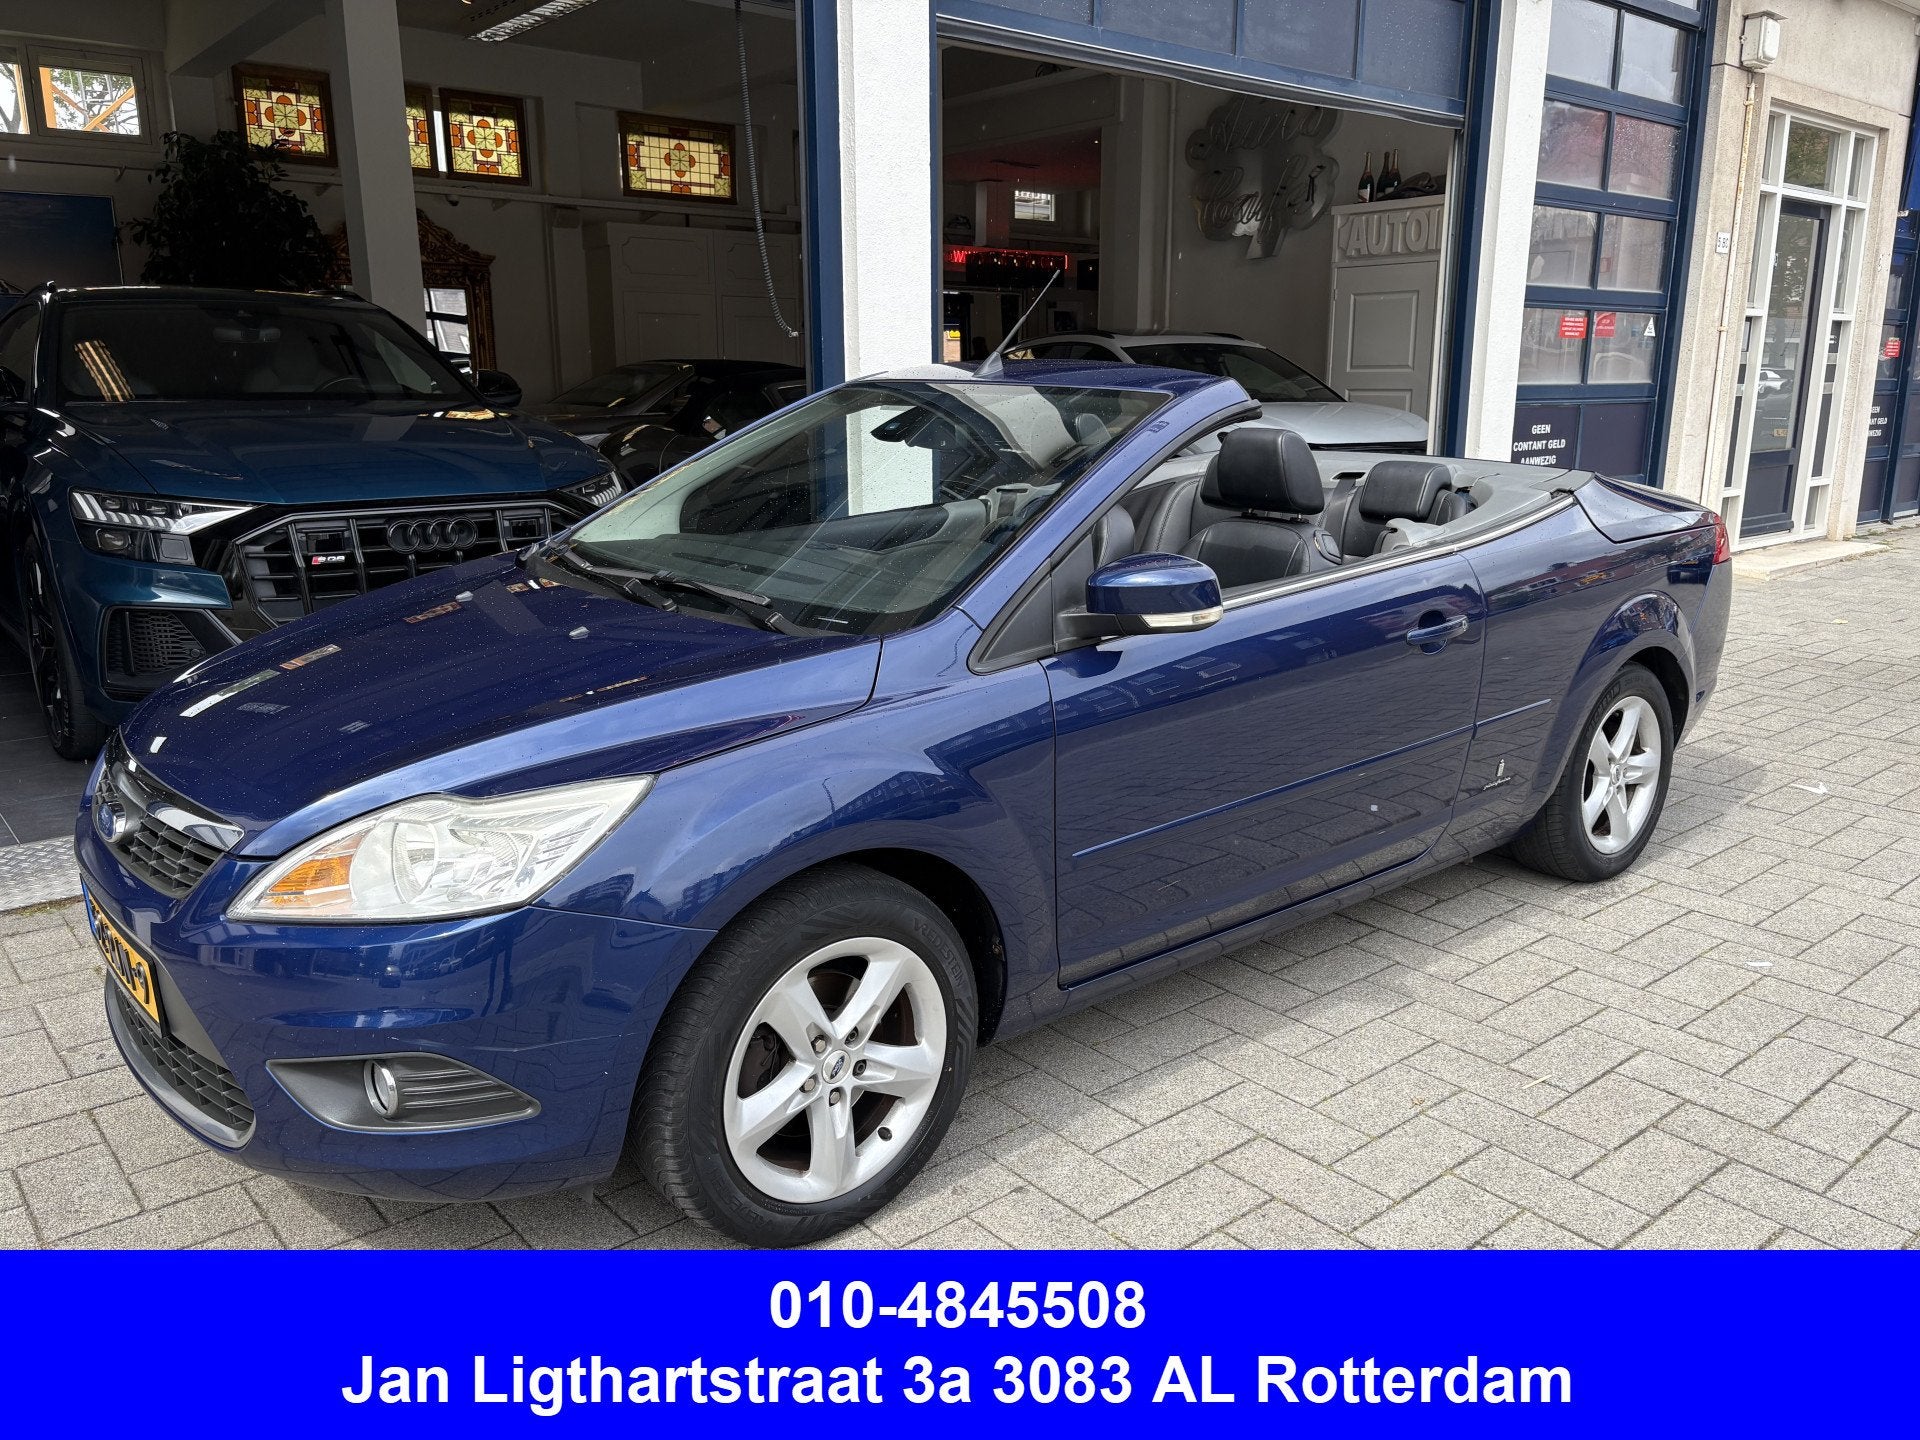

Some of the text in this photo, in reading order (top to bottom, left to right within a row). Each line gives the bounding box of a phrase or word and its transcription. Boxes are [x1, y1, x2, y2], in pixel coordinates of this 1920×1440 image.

[1531, 424, 1551, 434] GEEN
[1513, 438, 1566, 451] CONTANT GELD
